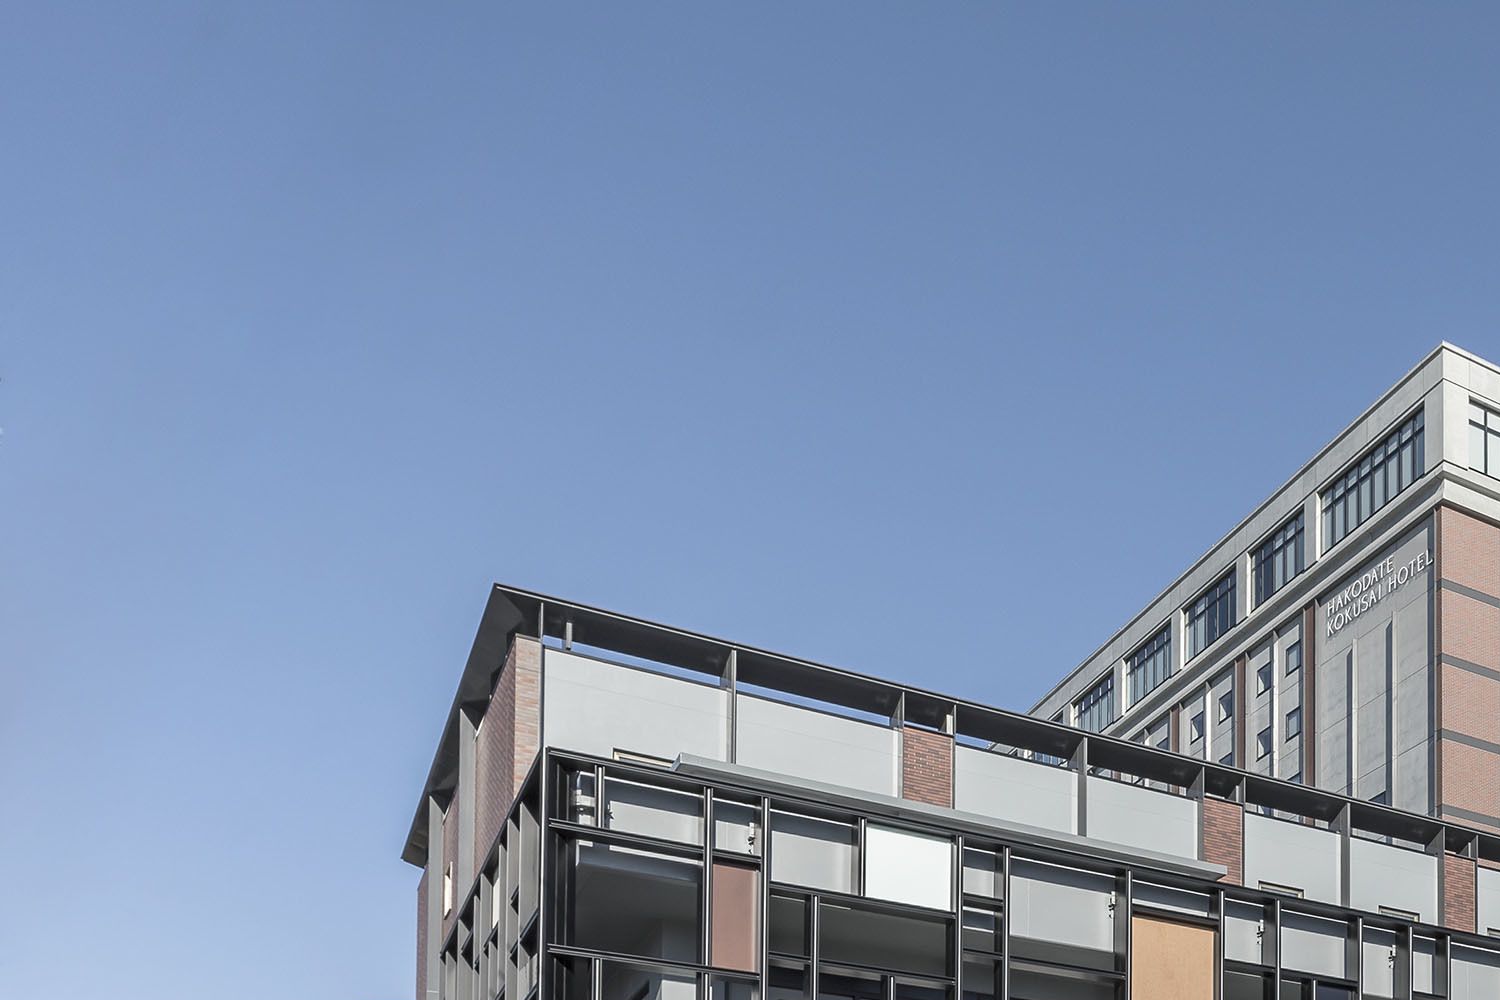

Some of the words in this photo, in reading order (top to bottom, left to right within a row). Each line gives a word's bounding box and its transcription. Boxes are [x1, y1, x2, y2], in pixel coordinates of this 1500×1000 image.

[1327, 555, 1395, 617] HAKODATE
[1327, 585, 1382, 637] KOKUSAI
[1388, 549, 1434, 592] HOTEL
